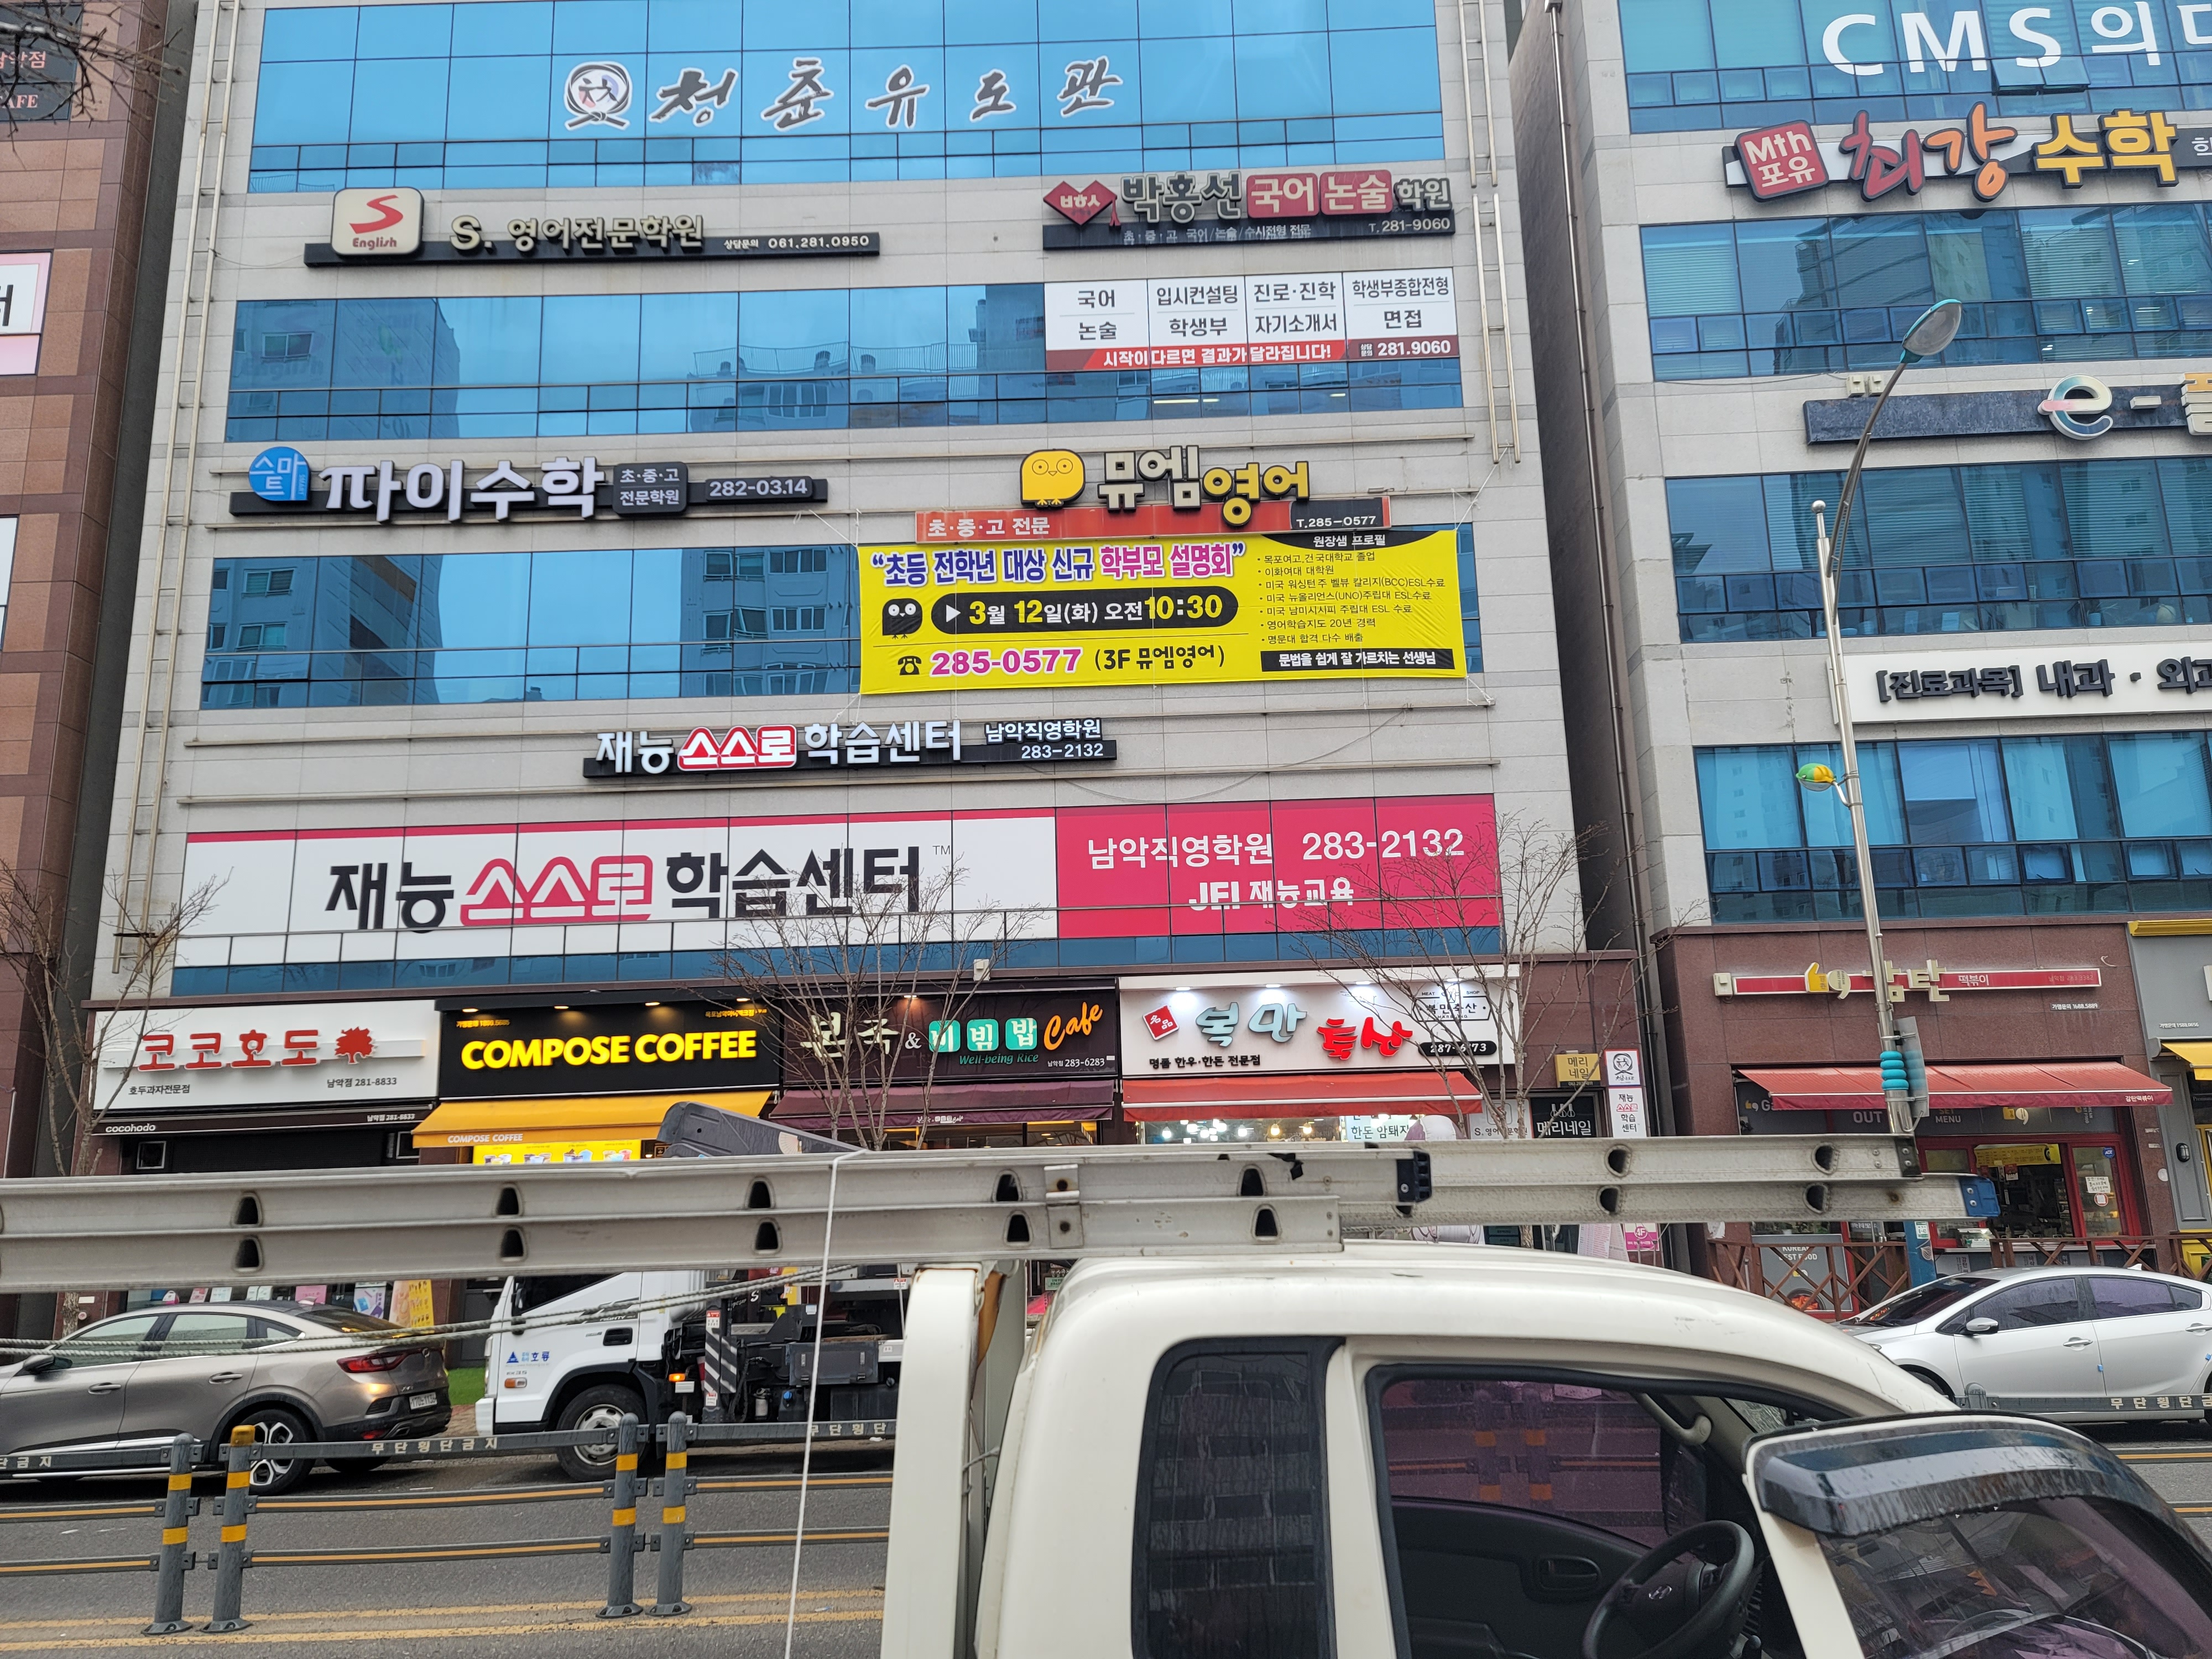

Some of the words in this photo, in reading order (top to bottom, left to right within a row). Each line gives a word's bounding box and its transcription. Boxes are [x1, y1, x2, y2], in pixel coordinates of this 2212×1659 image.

[1822, 8, 2061, 76] CMS
[0, 95, 39, 108] AFE
[649, 56, 1123, 131] 청춘유도관
[1744, 131, 1812, 165] Mth
[1840, 102, 2018, 202] 최강
[2033, 108, 2179, 188] 수학
[1758, 156, 1815, 187] 포유
[1121, 171, 1243, 223] 박홍선
[1250, 178, 1316, 211] 국어
[1324, 175, 1390, 210] 논술
[1394, 178, 1452, 211] 학원
[507, 215, 703, 252] 영어전문학원
[352, 237, 397, 251] English
[723, 239, 759, 250] 상담문의
[768, 236, 869, 249] 061.281.0950
[1254, 281, 1336, 302] 진로·진학
[1352, 276, 1449, 299] 학생부종합전형
[1077, 289, 1115, 309] 국어
[1156, 285, 1238, 307] 입시컨설팅
[1169, 317, 1228, 337] 학생부
[1255, 313, 1337, 334] 자기소개서
[1384, 309, 1422, 329] 면접
[1078, 322, 1117, 341] 논술
[1103, 350, 1148, 368] 시작이
[1151, 348, 1196, 366] 다르면
[1201, 347, 1247, 364] 결과가
[1250, 344, 1331, 362] 달라집니다!
[1378, 340, 1451, 356] 281.9060
[619, 468, 680, 483] 초·중·고
[619, 489, 680, 506] 전문학원
[928, 518, 1005, 538] 초·중·고
[1013, 517, 1050, 535] 전문
[1296, 514, 1376, 529] T.285-0577
[1313, 535, 1348, 547] 원장샘
[1351, 534, 1386, 546] 프로필
[934, 549, 997, 584] 전학년
[1003, 547, 1046, 582] 대상
[1052, 546, 1094, 581] 신규
[1100, 544, 1164, 580] 학부모
[1357, 551, 1375, 562] 졸업
[1265, 566, 1302, 577] 이화여대
[1306, 565, 1334, 575] 대학원
[1266, 579, 1284, 590] 미국
[1331, 578, 1350, 588] 벨뷰
[1266, 592, 1285, 603] 미국
[1395, 590, 1431, 600] ESL수료
[969, 601, 1006, 625] 3월
[1013, 600, 1098, 625] 12일(화)
[1266, 606, 1285, 616] 미국
[1289, 605, 1337, 615] 남미시시피
[1340, 604, 1369, 615] 주립대
[1372, 605, 1390, 613] ESL
[1393, 603, 1412, 614] 수료
[1266, 618, 1327, 630] 영어학습지도
[1329, 618, 1352, 628] 20년
[1356, 617, 1376, 628] 경력
[1267, 634, 1296, 644] 명문대
[1300, 633, 1318, 644] 합격
[1322, 633, 1342, 643] 다수
[1345, 632, 1364, 643] 배출
[930, 647, 1083, 677] 285-0577
[1279, 653, 1312, 667] 문법을
[1315, 652, 1338, 666] 쉽게
[1340, 652, 1353, 665] 잘
[1355, 651, 1400, 665] 가르치는
[1402, 651, 1436, 665] 선생님
[1876, 665, 2024, 703] [진료과목]
[2036, 659, 2116, 698] 내과
[984, 718, 1102, 743] 남악직영학원
[596, 731, 676, 774] 재능
[677, 724, 797, 771] 스스로
[804, 719, 961, 765] 학습센터
[1021, 742, 1104, 760] 283-2132
[1088, 833, 1273, 869] 남악직영학원
[1302, 828, 1465, 860] 283-2132
[325, 862, 454, 933] 재능
[460, 854, 653, 926] 스스로
[664, 845, 920, 919] 학습센터
[1188, 881, 1240, 911] JEI
[1249, 878, 1354, 909] 재능교육
[1958, 974, 1989, 987] 떡볶이
[1426, 1003, 1478, 1014] 복만축산
[1044, 1001, 1103, 1051] Cafe
[1150, 1014, 1173, 1030] 名品
[905, 1032, 922, 1050] &
[930, 1018, 1038, 1052] 비빔밥
[137, 1029, 321, 1072] 코코호도
[461, 1035, 630, 1070] COMPOSE
[635, 1029, 758, 1063] COFFEE
[1430, 1043, 1487, 1053] 287-673
[959, 1054, 1014, 1065] Well-being
[1017, 1053, 1039, 1063] Rice
[1065, 1058, 1105, 1067] 283-6283
[1149, 1057, 1171, 1070] 명품
[1175, 1056, 1224, 1067] 한우·한돈
[1228, 1055, 1260, 1066] 전문점
[1567, 1056, 1588, 1067] 메리
[1568, 1068, 1589, 1079] 네일
[128, 1084, 190, 1095] 호두과자전문점
[327, 1078, 353, 1088] 남악점
[354, 1077, 397, 1087] 281-8833
[1619, 1094, 1633, 1103] 재능
[1616, 1103, 1639, 1112] 스스로
[1621, 1113, 1636, 1123] 학습
[1853, 1111, 1882, 1124] OUT
[1936, 1115, 1961, 1124] MENU
[106, 1123, 156, 1133] cocohodo
[1351, 1125, 1374, 1140] 한돈
[1536, 1119, 1592, 1136] 메리네일
[1622, 1124, 1637, 1133] 센터
[447, 1134, 490, 1144] COMPOSE
[493, 1133, 524, 1142] COFFEE
